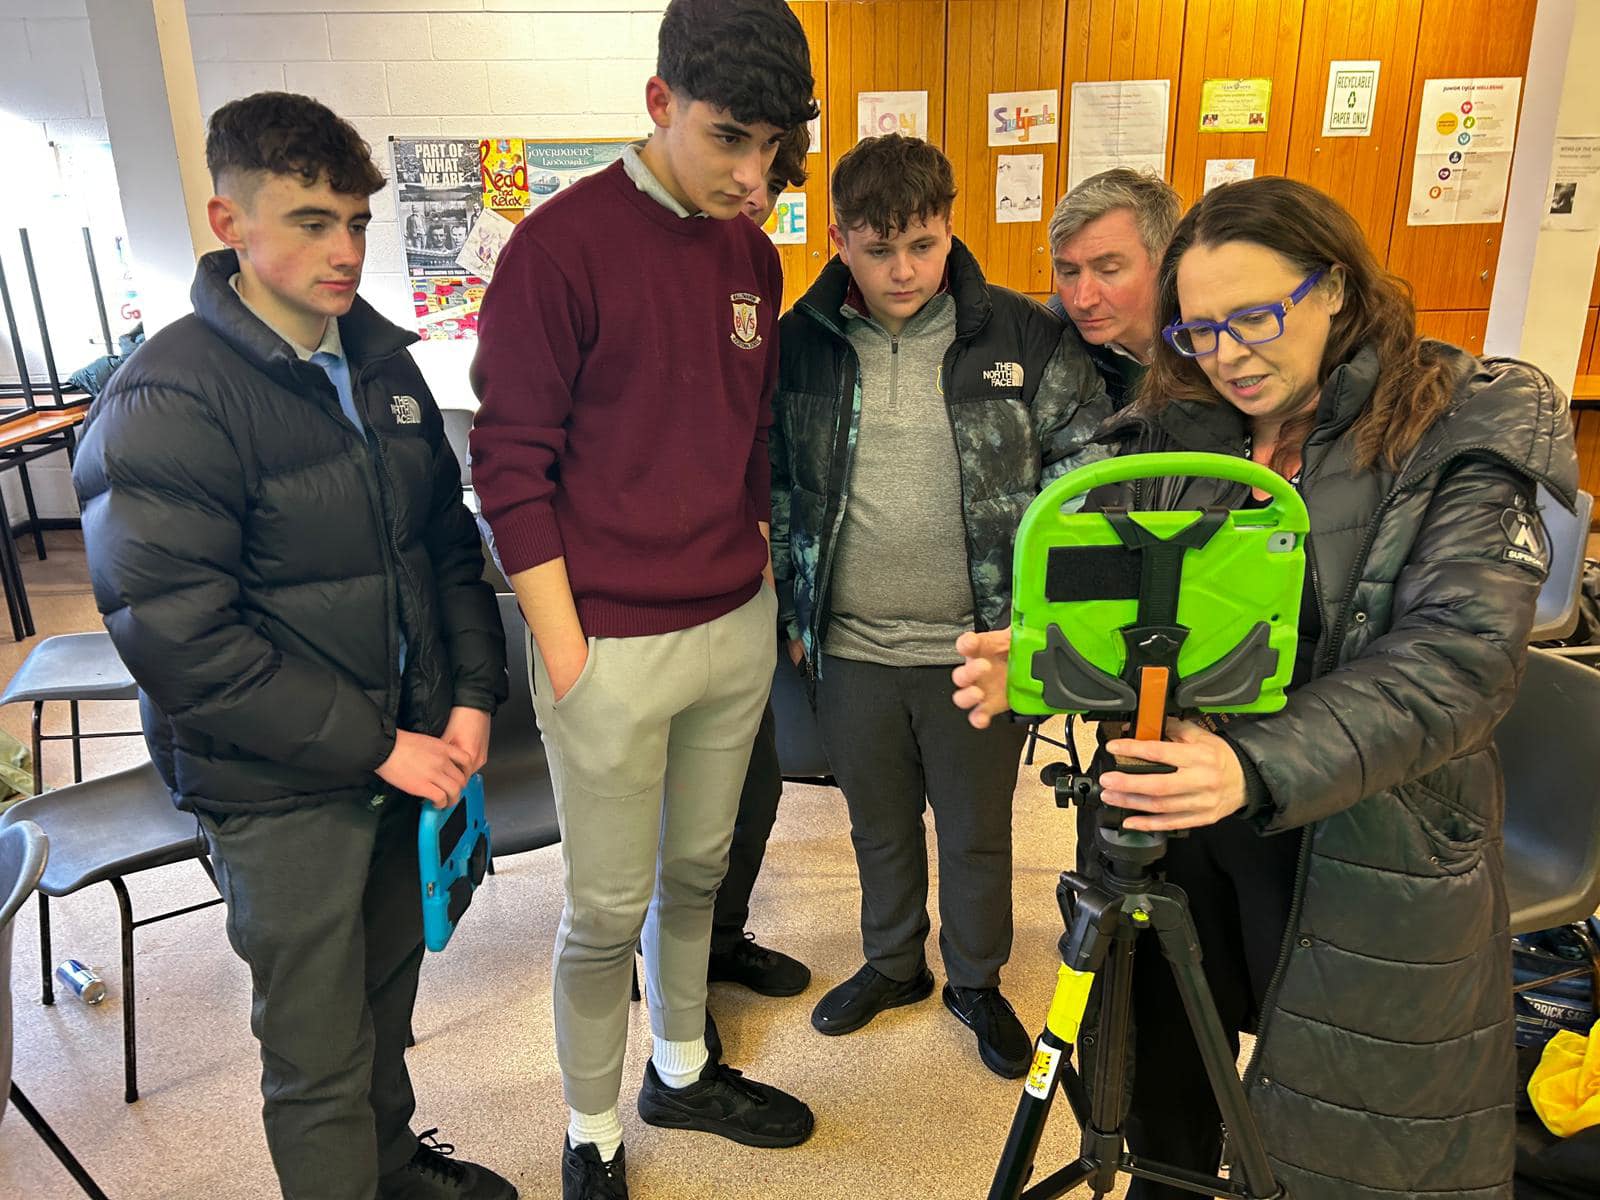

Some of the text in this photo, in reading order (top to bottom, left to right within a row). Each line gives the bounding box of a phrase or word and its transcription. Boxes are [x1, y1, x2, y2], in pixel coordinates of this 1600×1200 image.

[1337, 76, 1371, 88] RECYCLABLE
[993, 104, 1056, 142] Subjects
[1333, 112, 1367, 124] PAPER ONLY
[415, 143, 445, 158] PART
[448, 143, 464, 158] OF
[422, 158, 458, 173] WHAT
[420, 172, 465, 189] WE ARE
[491, 195, 521, 207] Relax
[995, 362, 1012, 371] THE
[983, 370, 1012, 380] NORTH
[991, 379, 1012, 387] FACE
